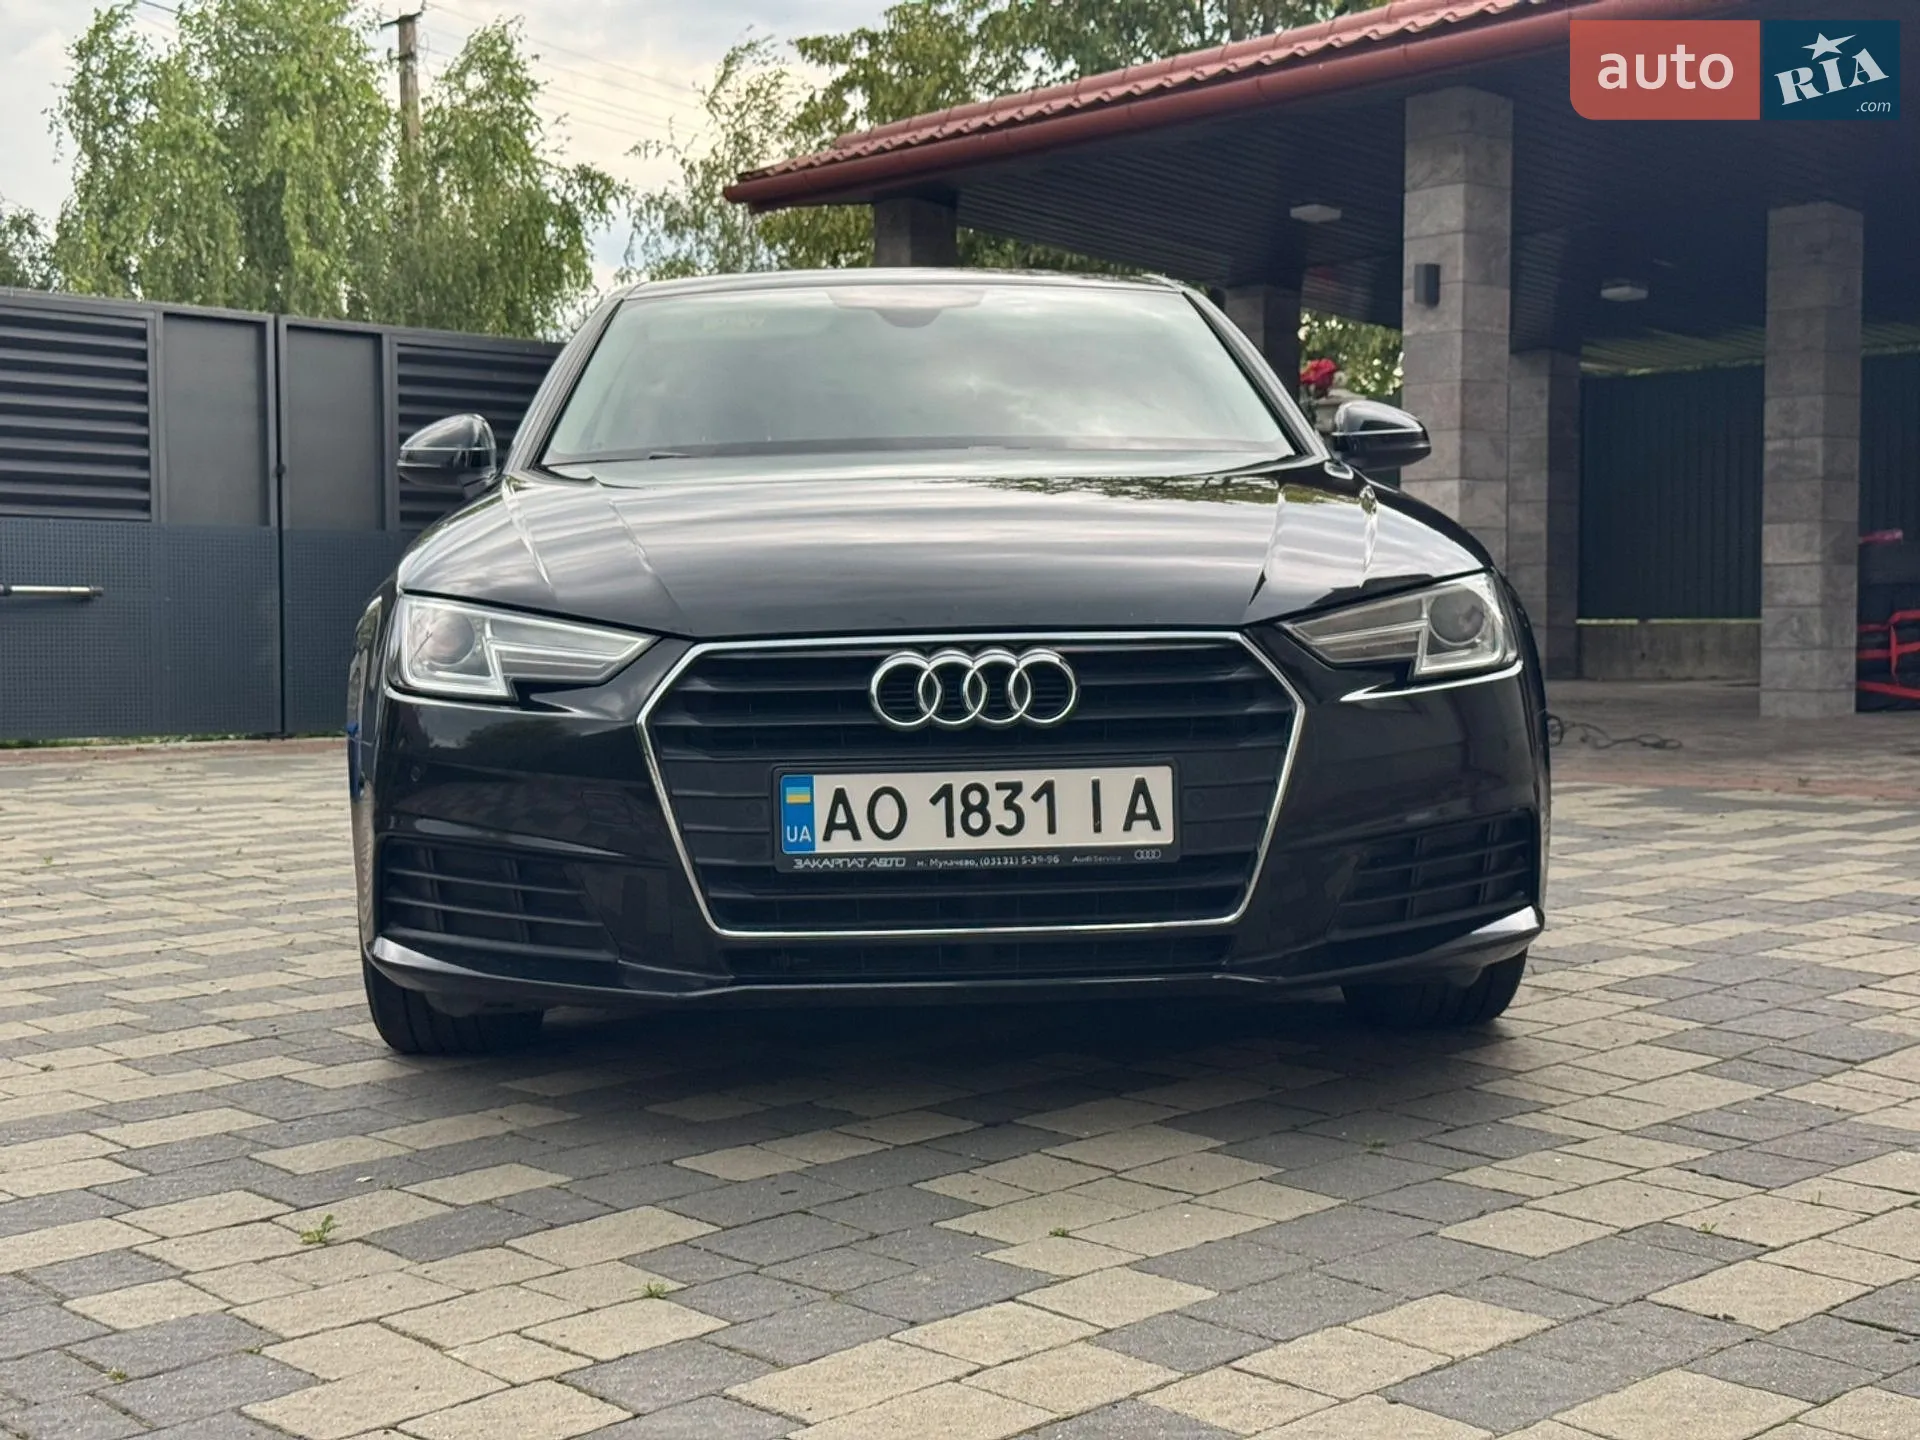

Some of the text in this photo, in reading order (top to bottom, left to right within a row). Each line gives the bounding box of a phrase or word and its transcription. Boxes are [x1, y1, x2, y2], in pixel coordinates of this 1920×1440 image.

[822, 777, 1162, 841] AO 1831 IA
[786, 825, 812, 842] UA
[793, 857, 866, 870] ЗАКАРПАТ
